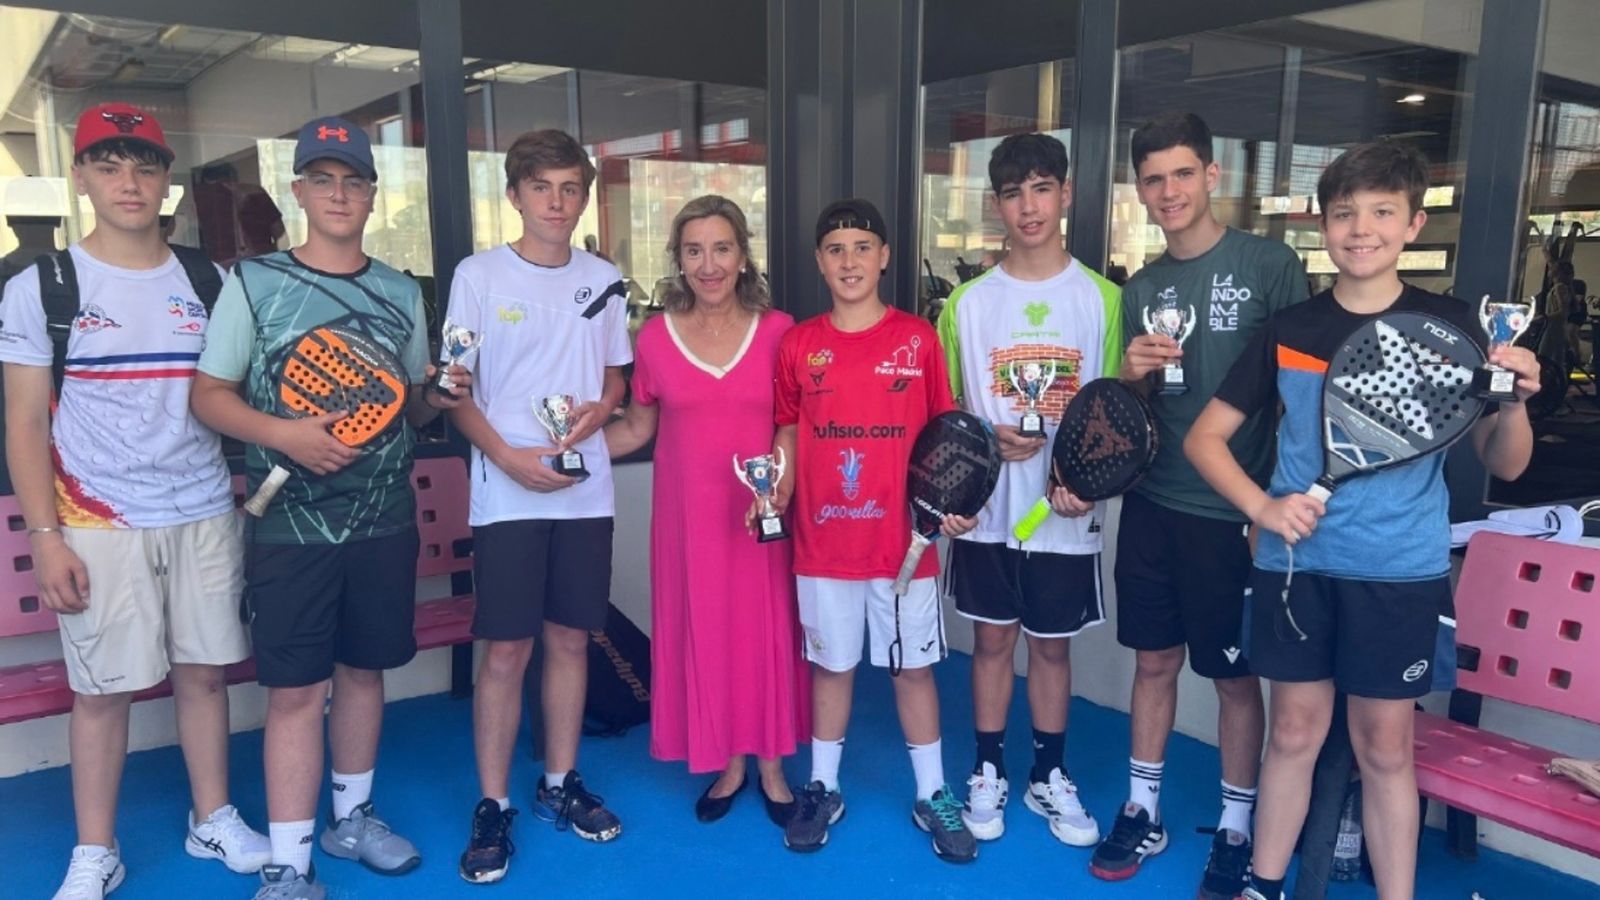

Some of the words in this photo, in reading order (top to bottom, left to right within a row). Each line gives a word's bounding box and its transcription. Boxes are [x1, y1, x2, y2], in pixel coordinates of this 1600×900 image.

[1213, 273, 1233, 287] LA
[1211, 287, 1251, 301] INDO
[897, 367, 922, 377] Madrid
